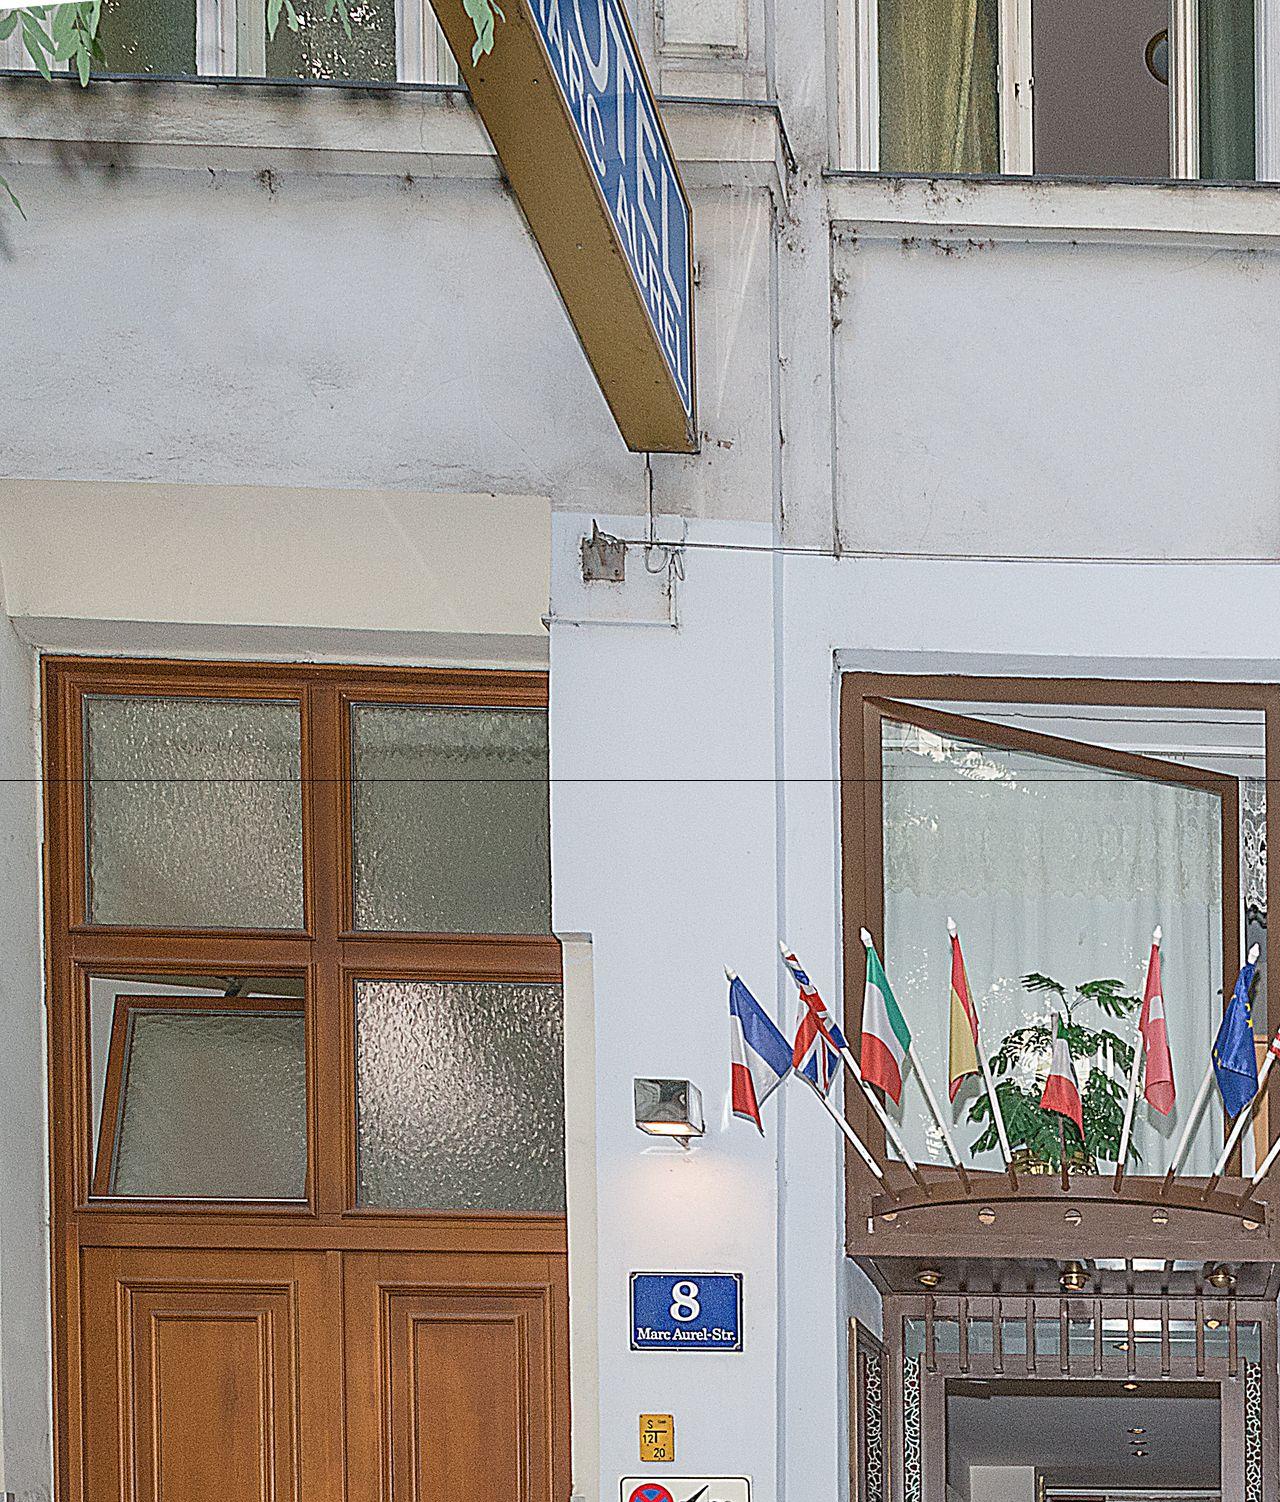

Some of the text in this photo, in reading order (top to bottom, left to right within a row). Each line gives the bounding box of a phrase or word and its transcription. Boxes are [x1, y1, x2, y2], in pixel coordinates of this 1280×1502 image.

[617, 174, 688, 396] AUREL
[669, 1280, 700, 1322] 8
[636, 1328, 737, 1341] Marc Aurel-Str.
[653, 1447, 666, 1458] 20
